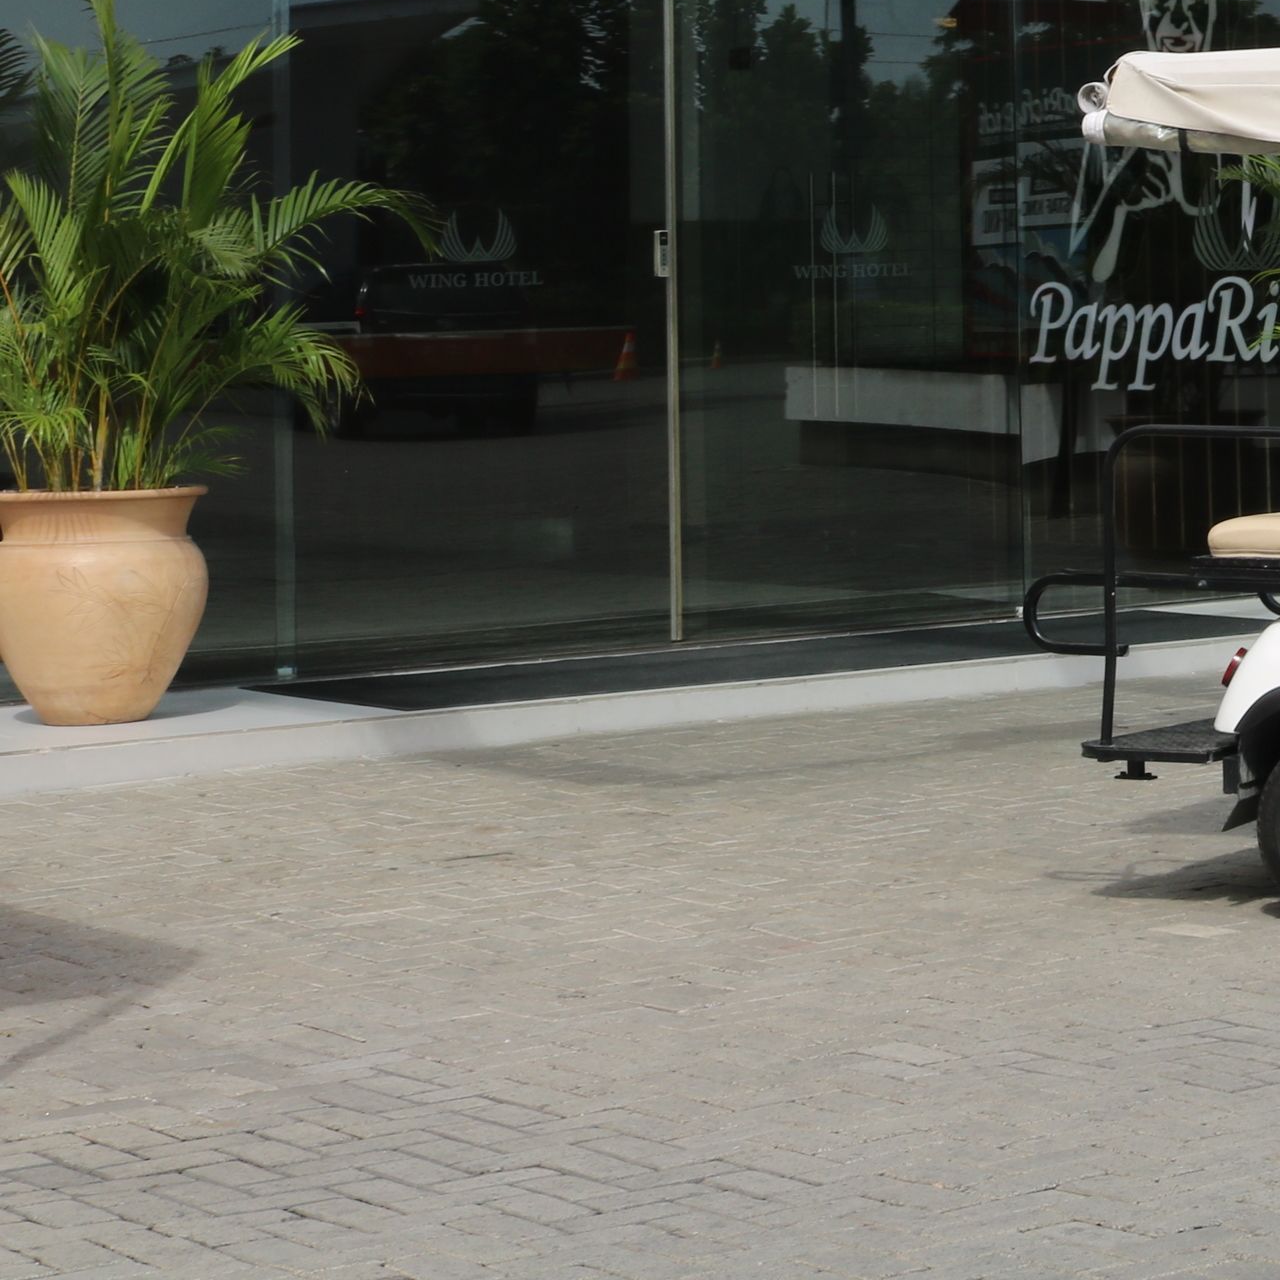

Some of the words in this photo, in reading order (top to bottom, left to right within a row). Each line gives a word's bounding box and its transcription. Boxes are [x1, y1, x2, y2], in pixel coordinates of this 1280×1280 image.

[408, 272, 467, 289] WING
[475, 270, 544, 288] HOTEL
[793, 264, 848, 280] WING
[850, 262, 912, 278] HOTEL
